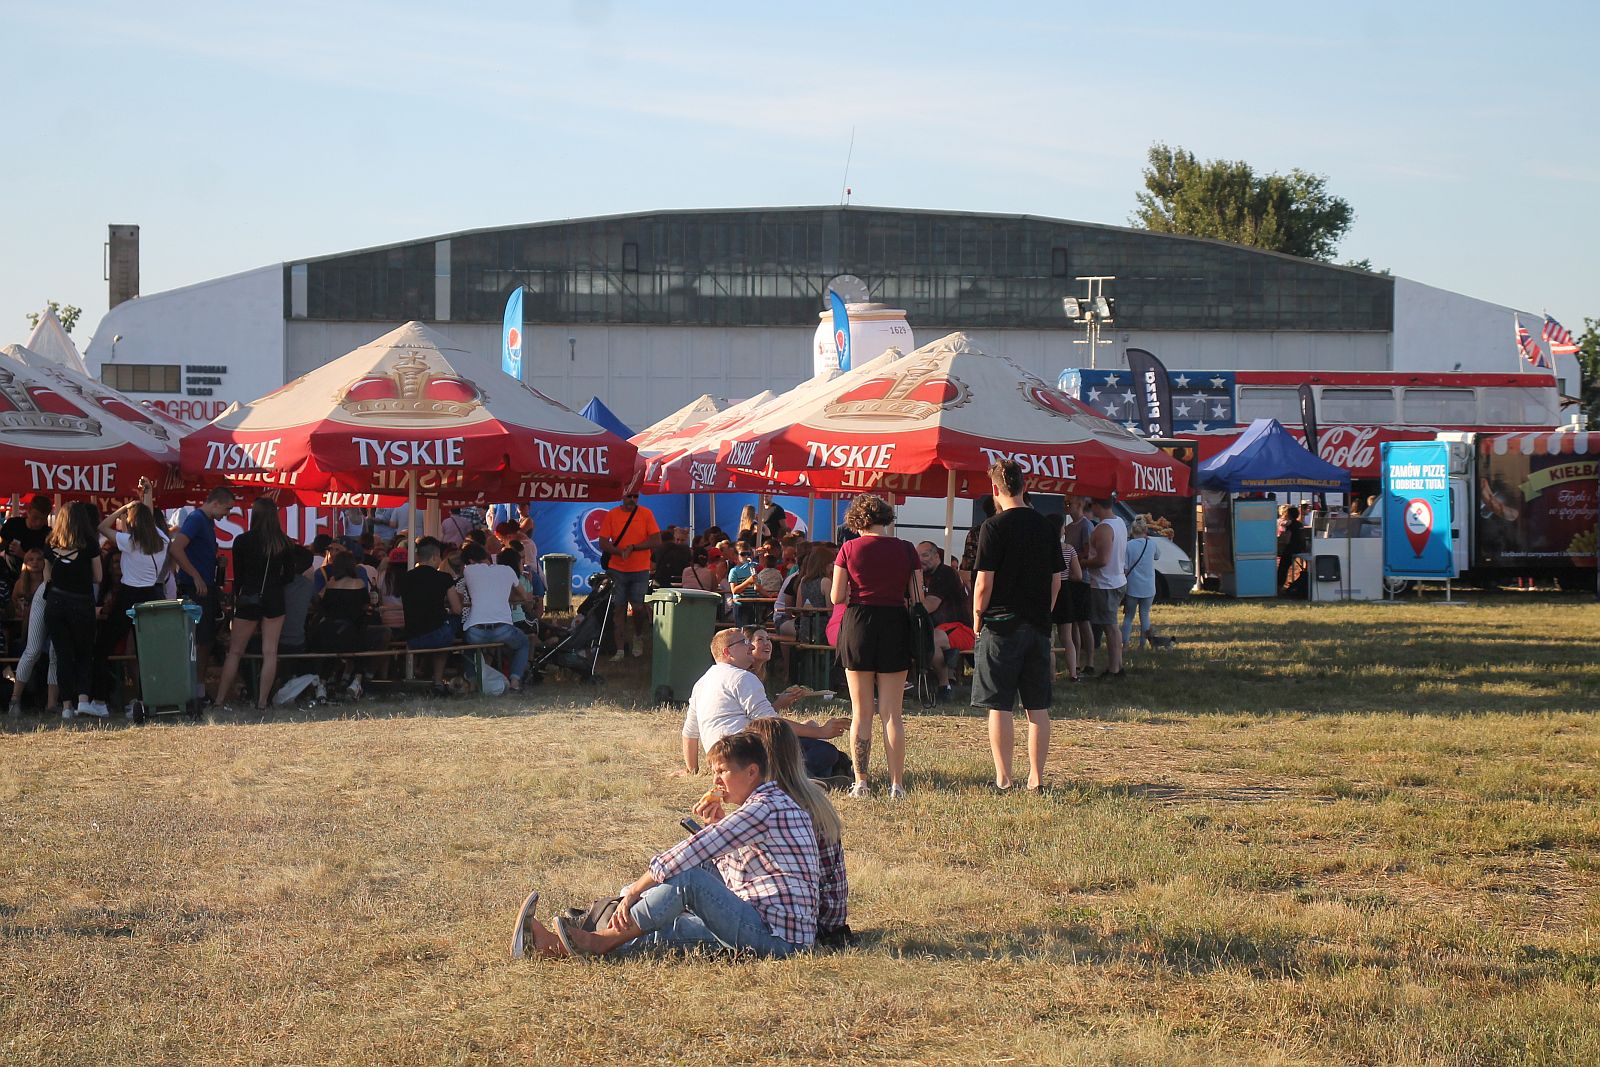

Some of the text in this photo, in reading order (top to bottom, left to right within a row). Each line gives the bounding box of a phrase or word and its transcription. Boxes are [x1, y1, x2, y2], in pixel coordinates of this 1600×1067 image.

[890, 326, 907, 335] 1629
[204, 438, 282, 470] TYSKIE
[352, 437, 465, 467] TYSKIE
[534, 438, 610, 475] TYSKIE
[727, 440, 760, 466] TYSKIE
[806, 441, 896, 469] TYSKIE
[24, 460, 118, 493] TYSKIE
[1132, 461, 1177, 493] TYSKIE
[1390, 462, 1421, 478] ZAMÓW
[1396, 479, 1424, 490] ODBIERZ
[1425, 479, 1446, 490] TUTAJ
